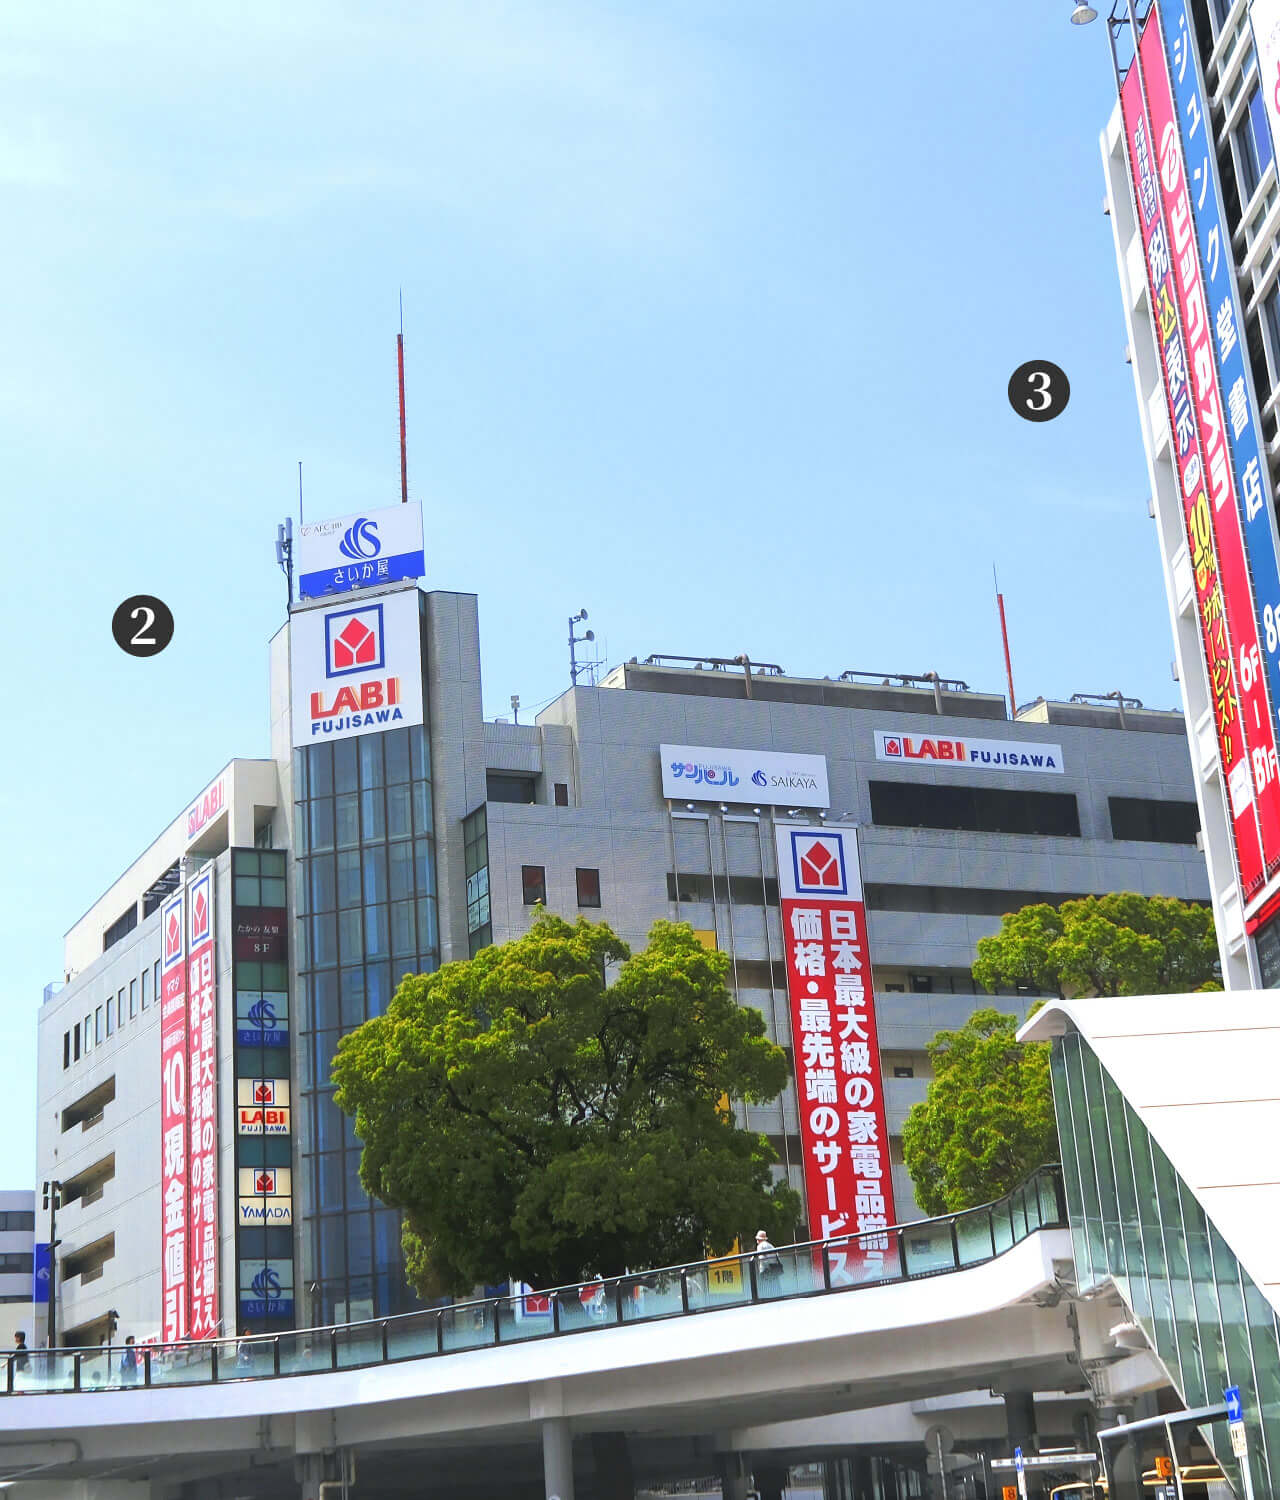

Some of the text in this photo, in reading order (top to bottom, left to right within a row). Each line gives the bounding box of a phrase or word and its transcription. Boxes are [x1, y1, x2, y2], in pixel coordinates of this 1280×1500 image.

[1174, 12, 1264, 523] ジュンク堂書店
[1148, 221, 1195, 458] 税込表示
[1170, 188, 1230, 514] ビックカメラ
[334, 559, 389, 584] さいか屋
[310, 677, 400, 720] LABI
[1239, 642, 1277, 796] 6F B1F
[311, 707, 404, 736] FUJISAWA
[902, 736, 1057, 769] LABI FUJISAWA
[770, 775, 818, 790] SAIKAYA
[195, 779, 225, 832] LABI
[790, 906, 852, 1286] 価格・最先端のサービス
[828, 909, 889, 1281] 日本最大級の家電品揃え
[241, 1110, 286, 1124] LABI
[241, 1124, 287, 1132] FUJISAWA
[240, 1205, 290, 1218] YAMADA
